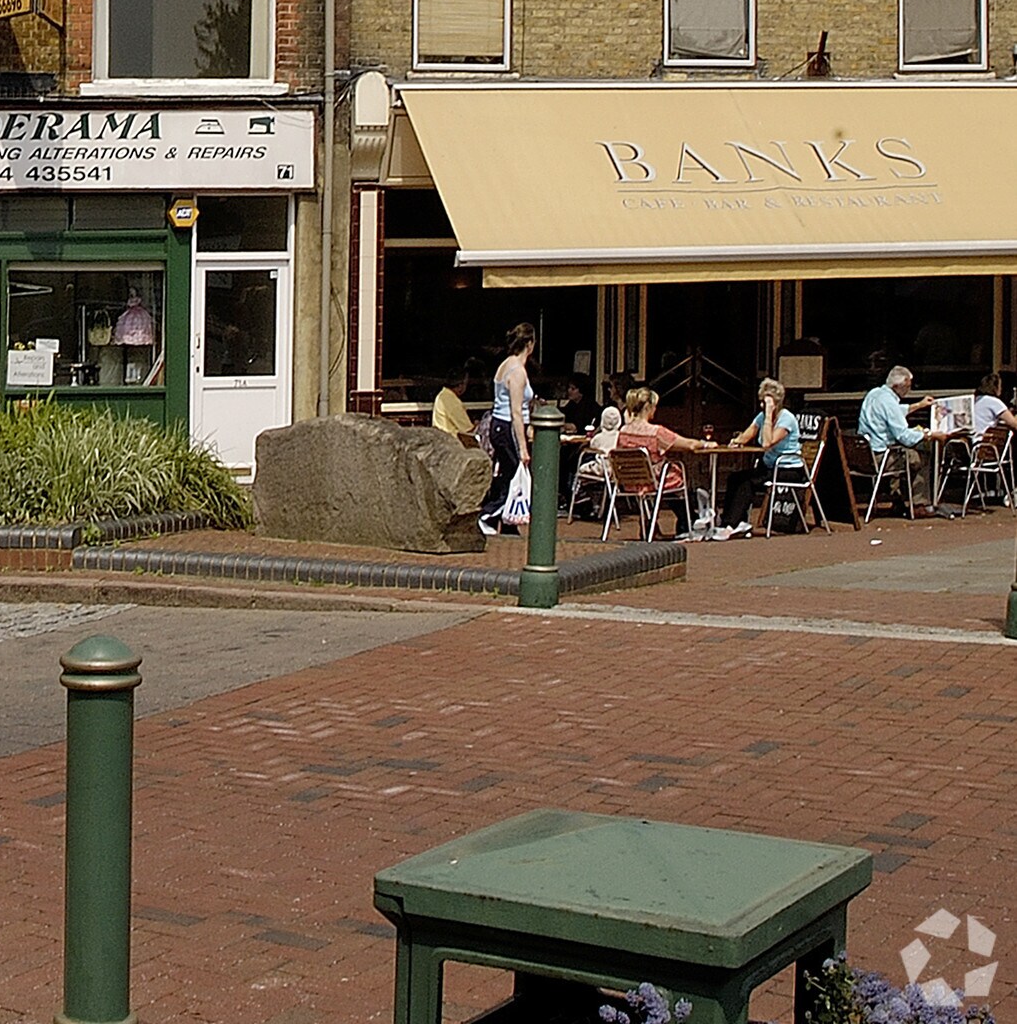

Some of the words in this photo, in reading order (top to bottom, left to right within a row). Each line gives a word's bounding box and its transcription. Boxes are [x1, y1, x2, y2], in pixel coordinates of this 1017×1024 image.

[28, 146, 157, 160] ALTERATIONS
[164, 146, 178, 160] &
[187, 146, 268, 159] REPAIRS
[594, 137, 928, 184] BANKS
[25, 165, 112, 182] 435541
[277, 165, 294, 179] 71
[703, 198, 751, 211] BAR
[792, 191, 944, 209] RESTAURANT
